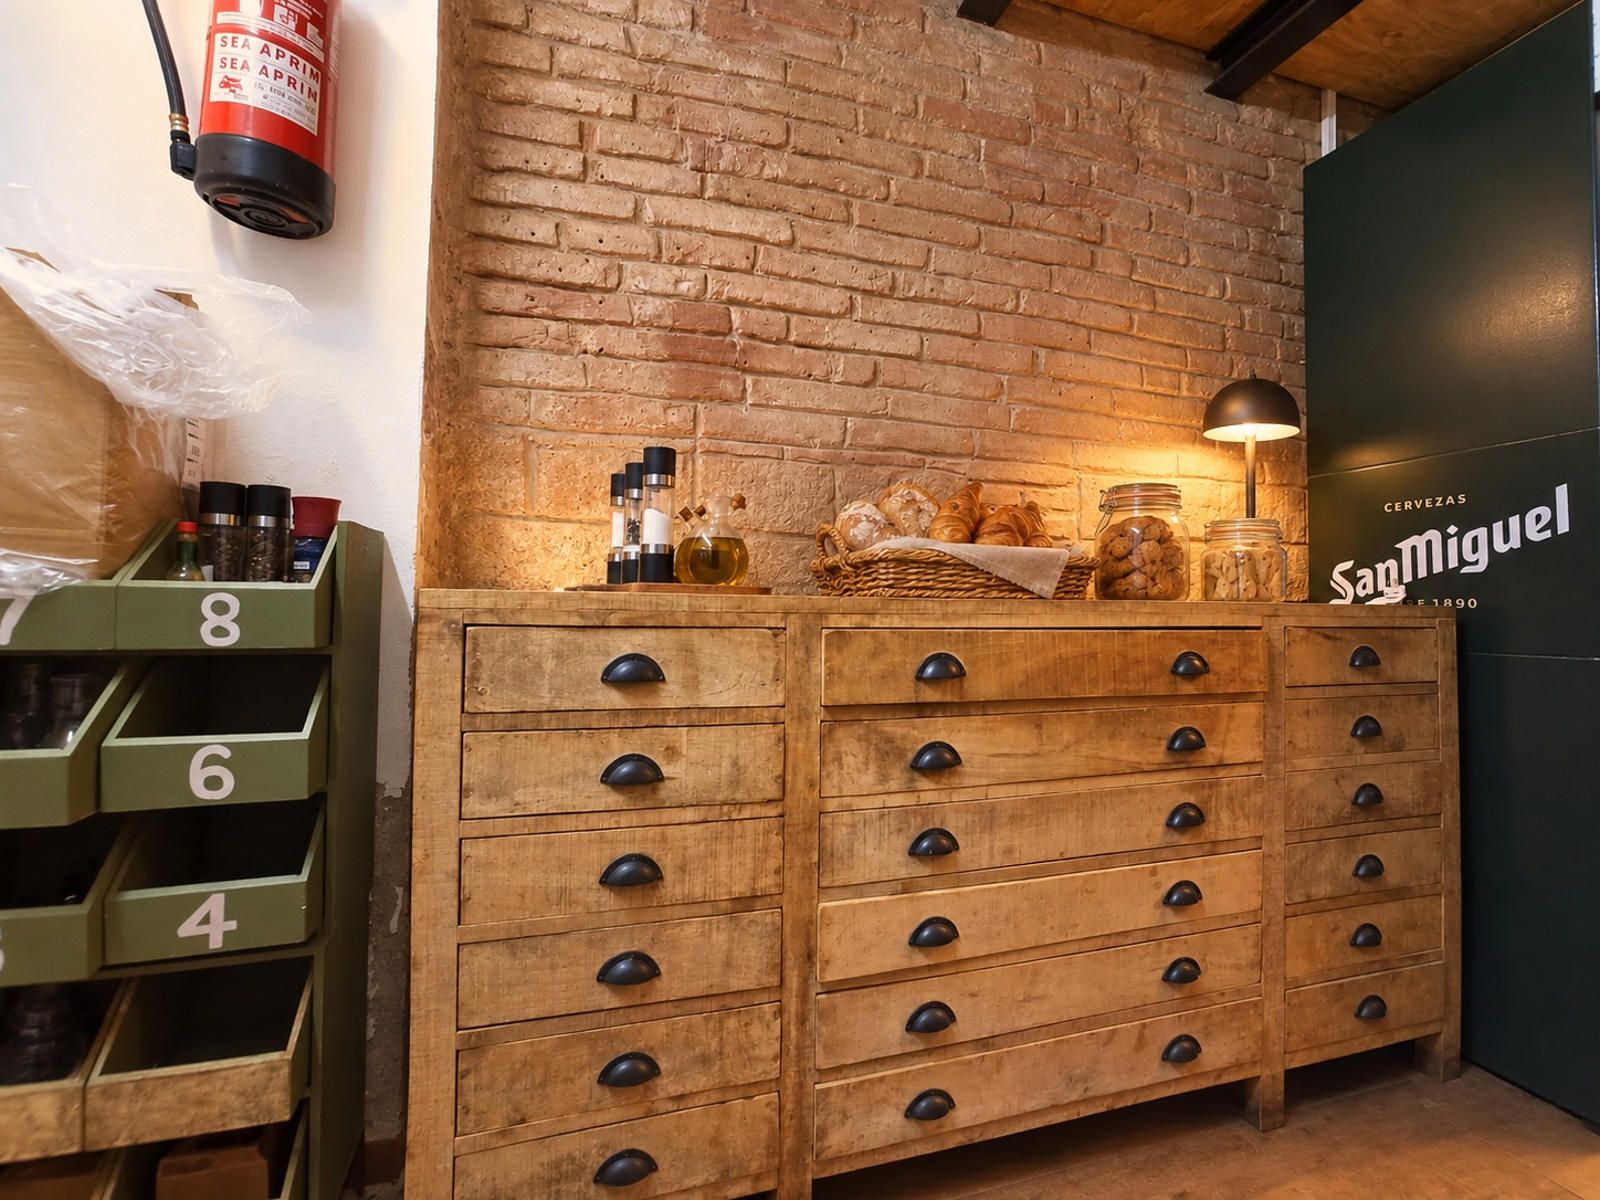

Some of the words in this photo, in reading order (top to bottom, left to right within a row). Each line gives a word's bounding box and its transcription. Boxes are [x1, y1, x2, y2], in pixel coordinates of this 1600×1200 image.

[220, 35, 251, 50] SEA
[219, 56, 250, 72] SEA
[1384, 493, 1467, 513] CERVEZAS
[1329, 559, 1401, 605] San
[1395, 483, 1570, 583] Miguel
[200, 592, 241, 647] 8
[1432, 598, 1478, 609] 1890
[189, 744, 235, 800] 6
[177, 893, 238, 949] 4
